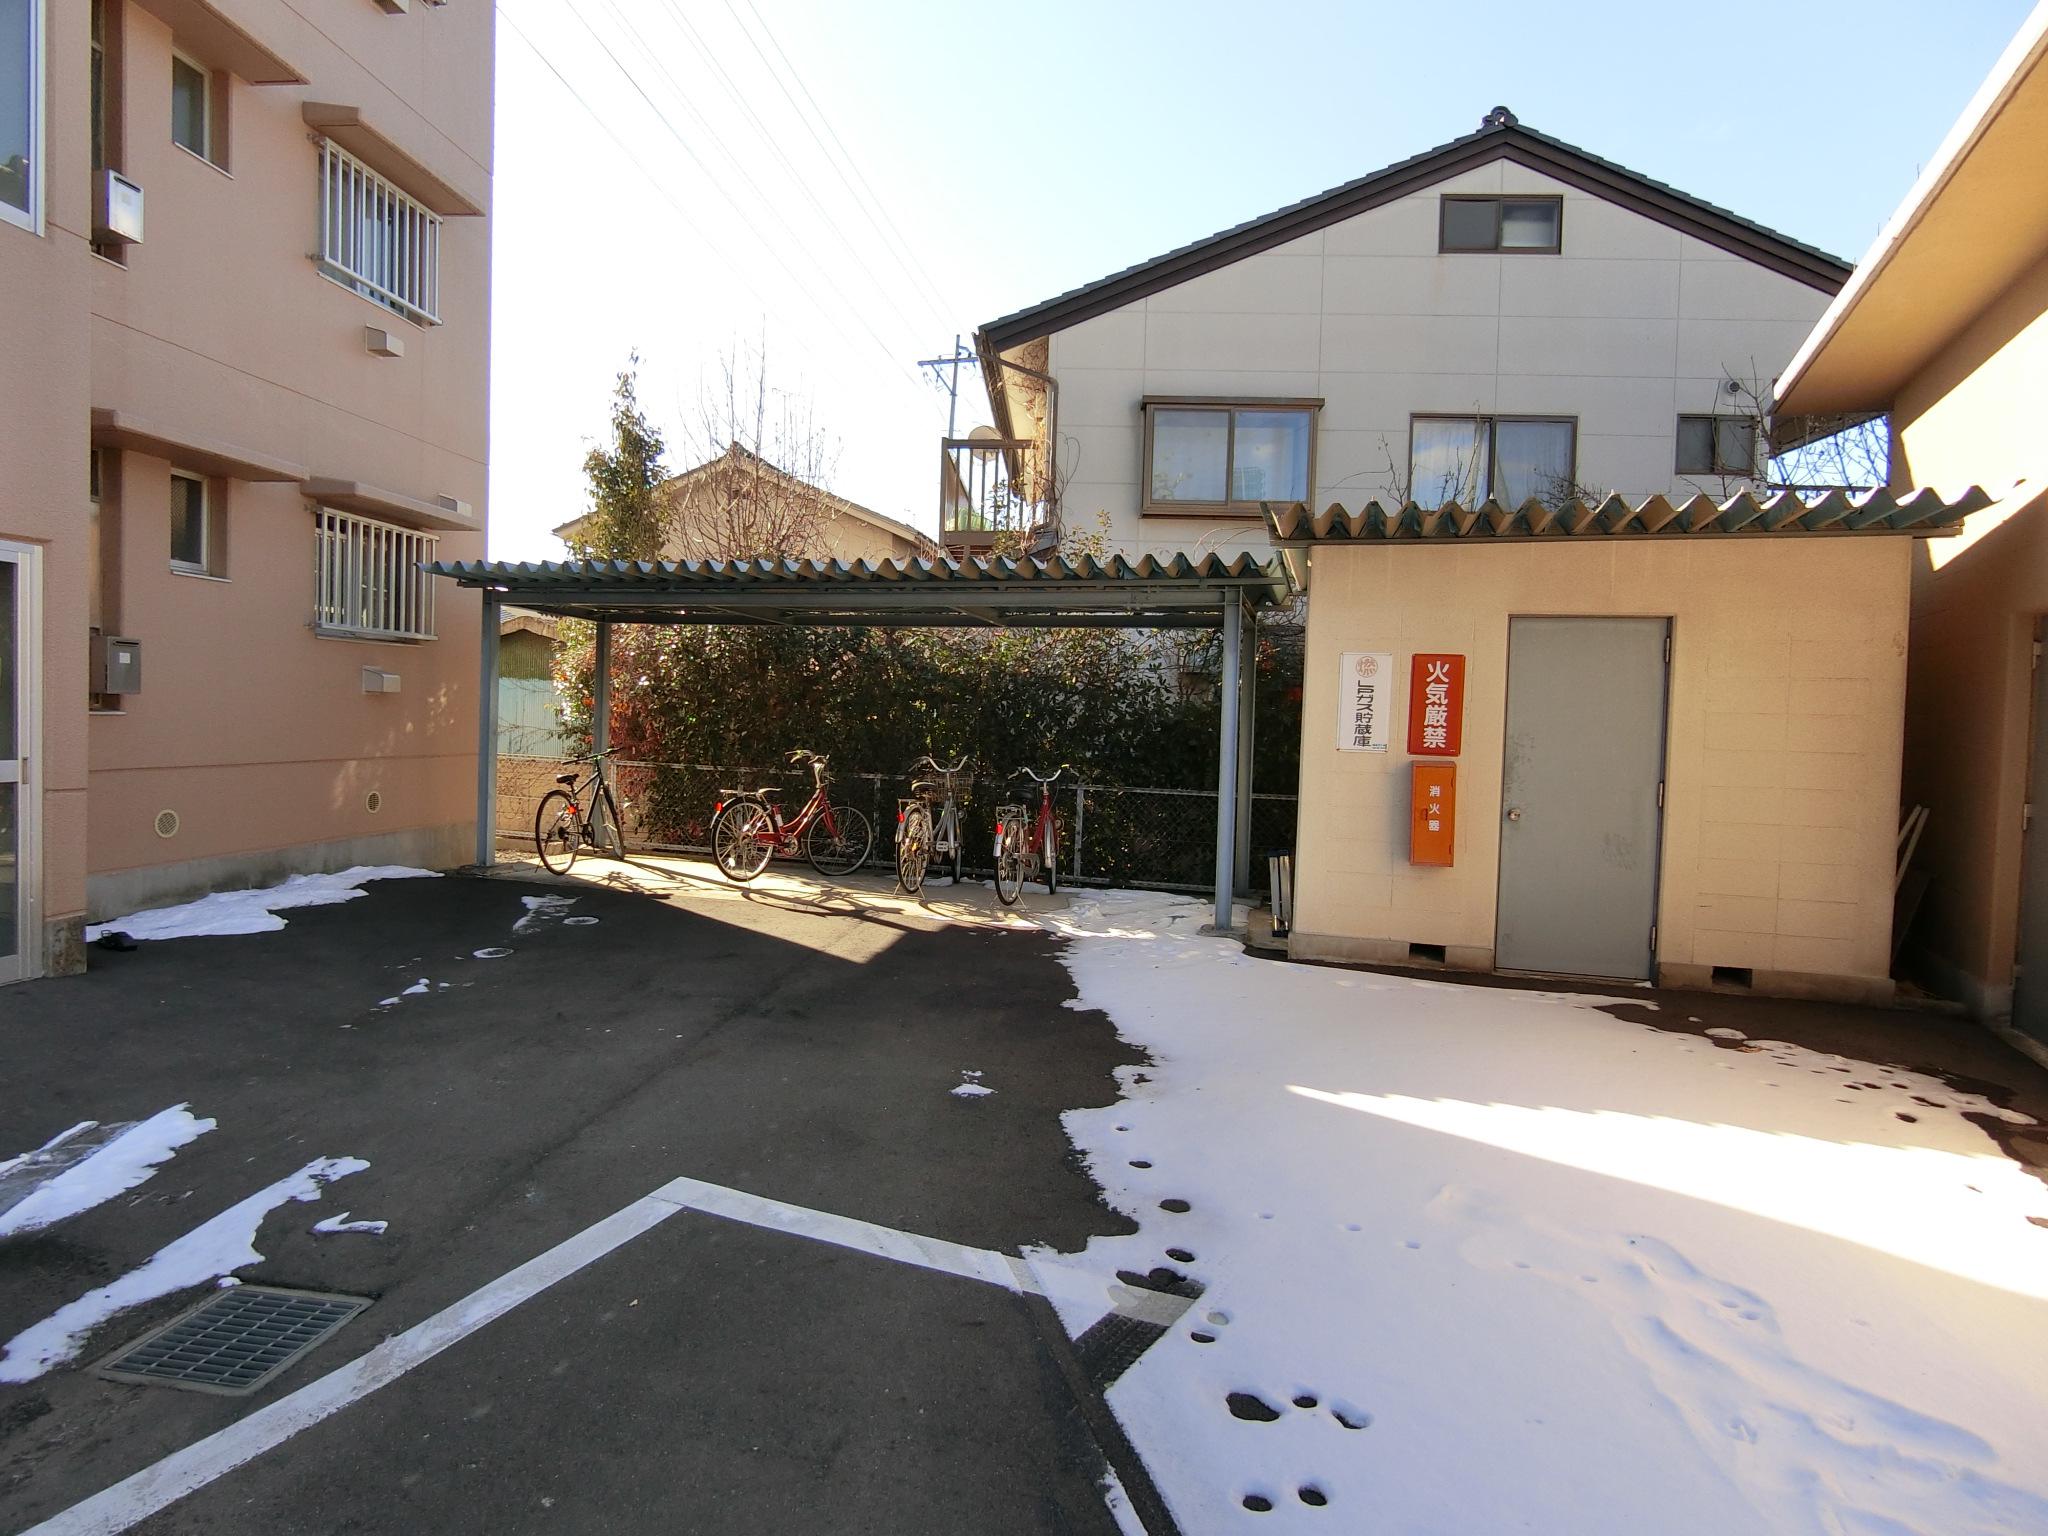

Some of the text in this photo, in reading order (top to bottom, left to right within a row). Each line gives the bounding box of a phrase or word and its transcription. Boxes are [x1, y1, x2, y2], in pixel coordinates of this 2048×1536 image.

[1353, 680, 1374, 747] LPガス貯蔵庫
[1424, 661, 1449, 748] 火気厳禁
[1429, 785, 1440, 831] 消火器
